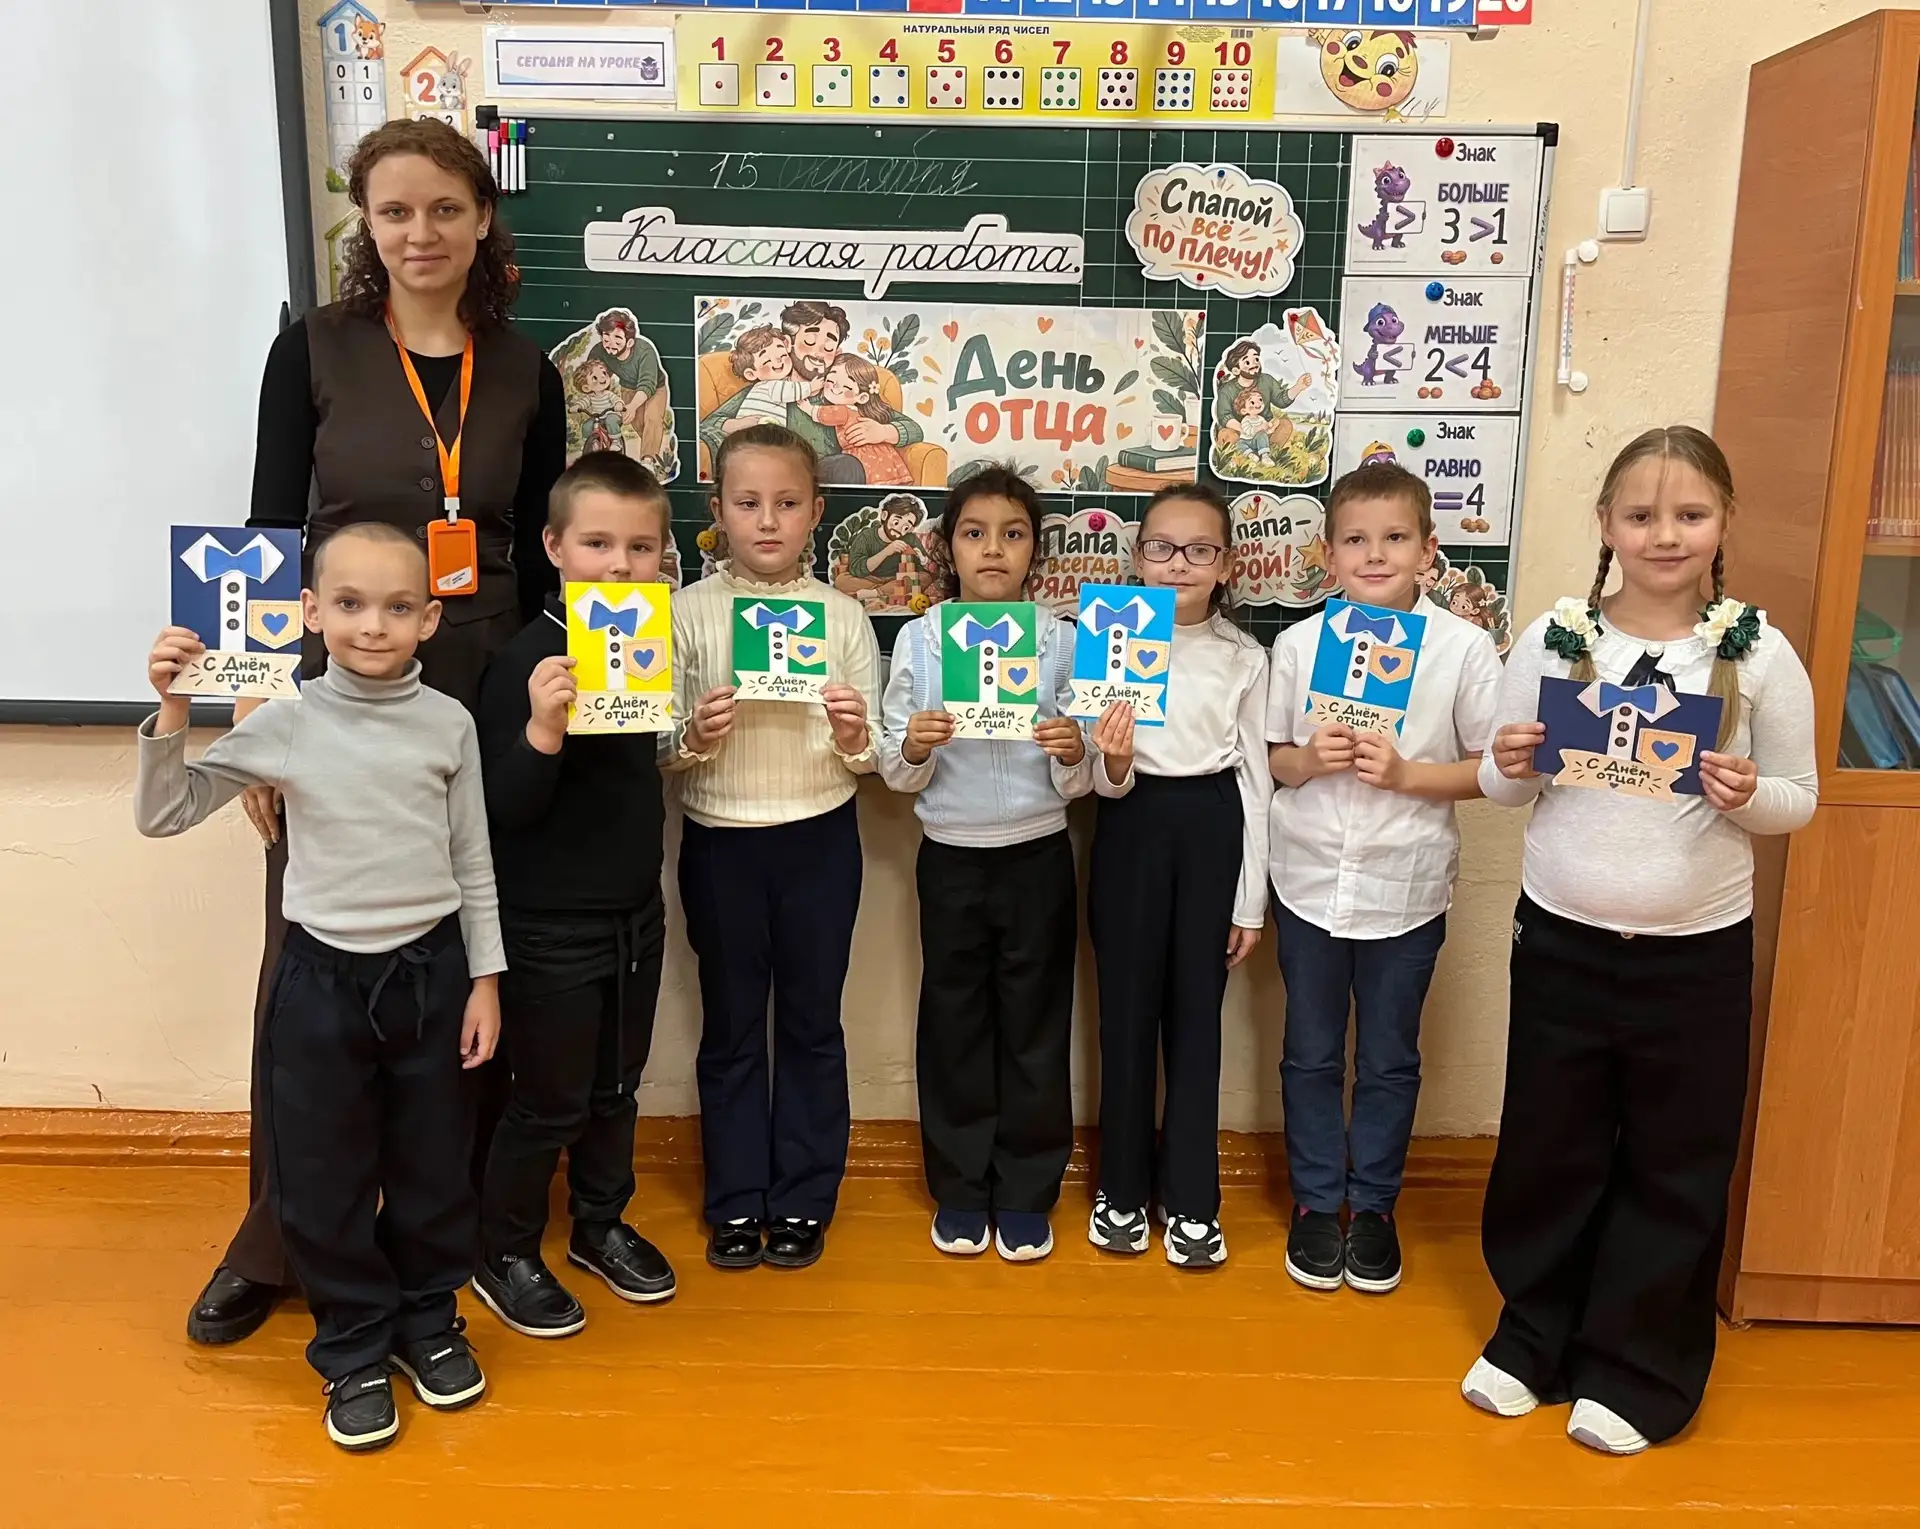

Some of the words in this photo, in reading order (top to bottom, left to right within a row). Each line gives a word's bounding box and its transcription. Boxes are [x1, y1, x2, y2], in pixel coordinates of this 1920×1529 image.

[333, 23, 347, 51] 1
[903, 24, 985, 34] НАТУРАЛЬНЫЙ
[988, 25, 1010, 35] РЯД
[1013, 26, 1050, 35] ЧИСЕЛ
[711, 37, 726, 61] 1
[765, 38, 784, 62] 2
[823, 38, 841, 62] 3
[879, 39, 899, 62] 4
[937, 39, 956, 63] 5
[994, 39, 1014, 64] 6
[1052, 41, 1072, 65] 7
[1110, 41, 1128, 65] 8
[1167, 41, 1186, 66] 9
[1214, 41, 1252, 66] 10
[337, 64, 346, 79] 0
[362, 65, 370, 79] 1
[516, 55, 575, 68] СЕГОДНЯ
[577, 56, 596, 69] НА
[599, 56, 641, 69] УРОКЕ
[338, 85, 346, 100] 1
[363, 86, 373, 101] 0
[416, 72, 437, 103] 2
[1455, 142, 1497, 162] Знак
[709, 152, 762, 189] 15
[1160, 177, 1188, 214] С
[1187, 190, 1274, 228] папой
[1437, 183, 1510, 204] БОЛЬШЕ
[1191, 216, 1233, 242] всё
[618, 214, 864, 271] Классная
[871, 223, 1081, 294] работа.
[1443, 288, 1484, 307] Знак
[1423, 325, 1499, 344] МЕНЬШЕ
[946, 333, 1106, 412] День
[965, 397, 1107, 453] отца
[1436, 421, 1476, 440] Знак
[1424, 458, 1482, 478] РАВНО
[1041, 523, 1118, 557] Папа
[1047, 556, 1120, 575] всегда
[203, 656, 217, 671] С
[222, 656, 270, 672] Днём
[215, 672, 265, 684] отца!
[758, 675, 768, 686] С
[773, 675, 807, 687] Днём
[767, 684, 804, 694] отца!
[1091, 686, 1101, 698] С
[1105, 685, 1141, 698] Днём
[594, 697, 605, 710] С
[610, 696, 649, 710] Днём
[1328, 702, 1339, 713] С
[1342, 704, 1380, 720] Днём
[605, 708, 645, 721] отца!
[966, 708, 976, 720] С
[980, 707, 1015, 720] Днём
[1336, 715, 1375, 729] отца!
[974, 719, 1012, 730] отца!
[1586, 758, 1600, 769] С
[1604, 761, 1650, 778] Днём
[1596, 772, 1645, 787] отца!
